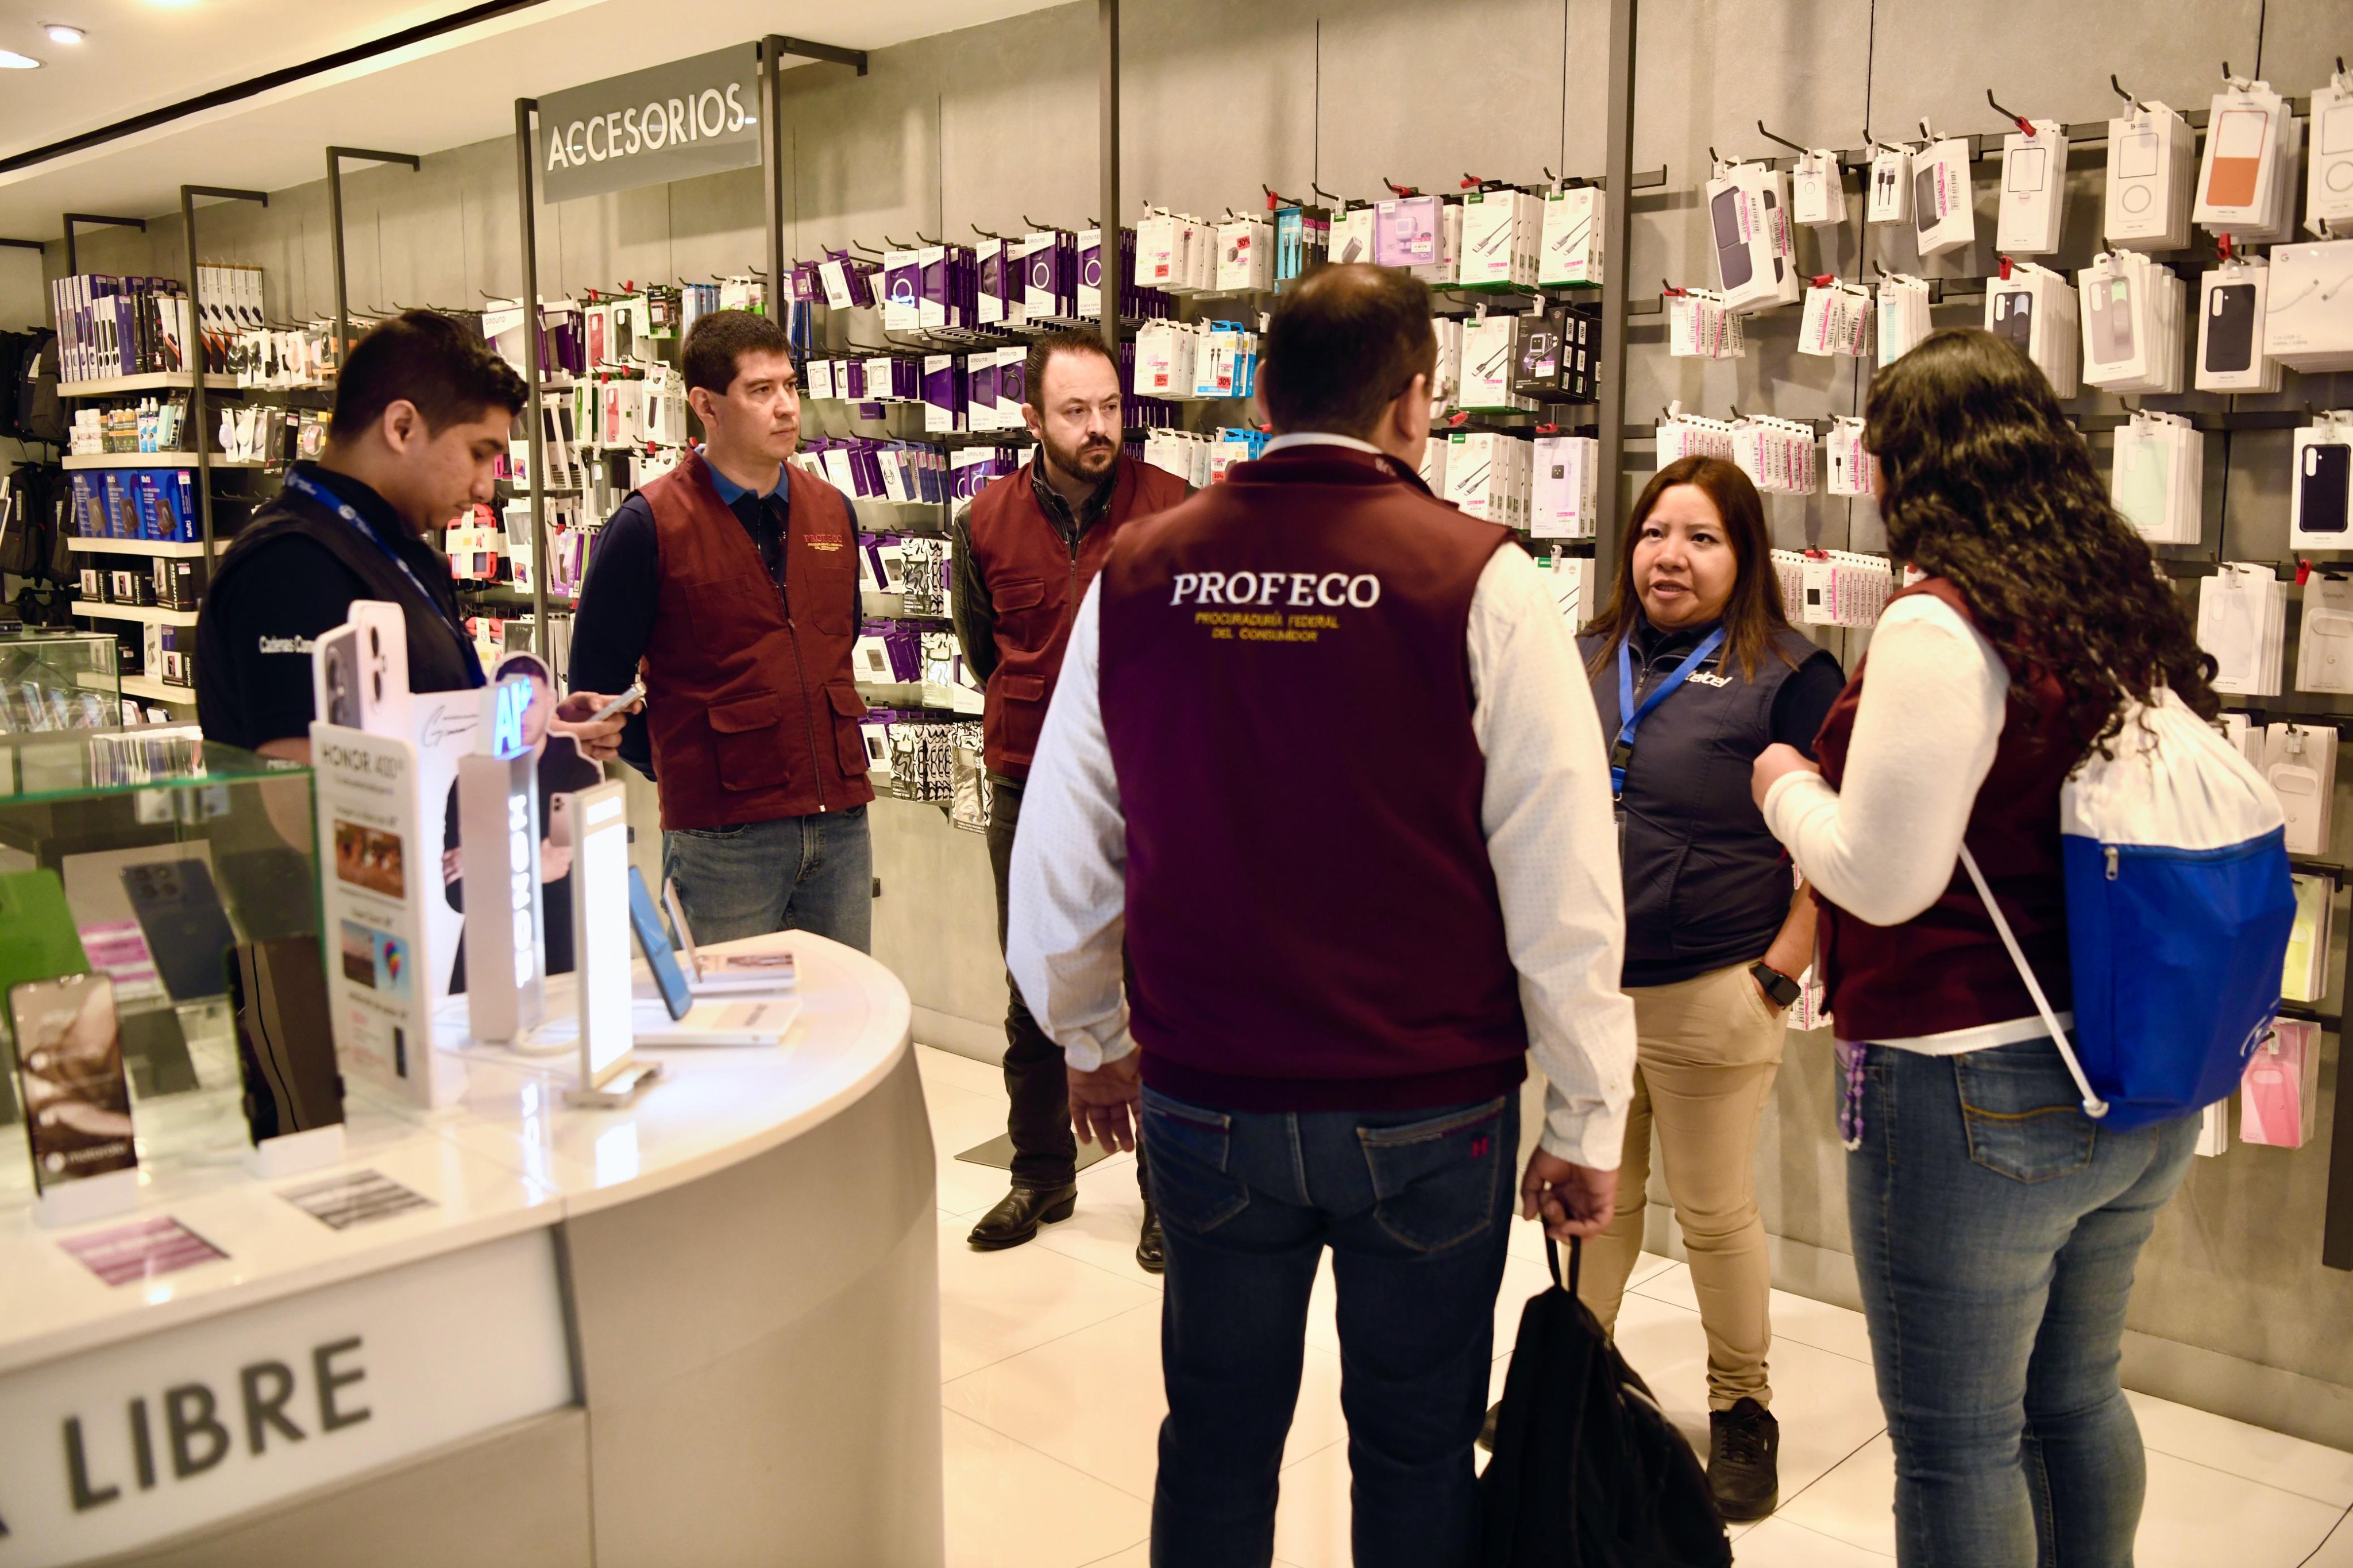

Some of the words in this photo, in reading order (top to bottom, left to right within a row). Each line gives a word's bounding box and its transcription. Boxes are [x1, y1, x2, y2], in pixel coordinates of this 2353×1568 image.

[547, 83, 746, 171] ACCESORIOS
[1239, 237, 1251, 248] 30%
[485, 316, 506, 325] GROUND
[1218, 377, 1231, 386] 30%
[185, 520, 193, 538] Multi
[803, 534, 843, 543] PROFECO
[862, 550, 873, 573] GROUND
[170, 563, 178, 610] GROUND
[1168, 571, 1380, 608] PROFECO
[1194, 610, 1283, 628] PROCURADURÍA
[1288, 613, 1340, 629] FEDERAL
[259, 635, 294, 654] Cadenas
[1212, 627, 1235, 639] DEL
[1239, 627, 1319, 643] CONSUMIDOR
[1684, 670, 1733, 688] telcel
[322, 743, 372, 773] HONOR
[508, 794, 533, 989] HONOR
[62, 1335, 372, 1517] LIBRE
